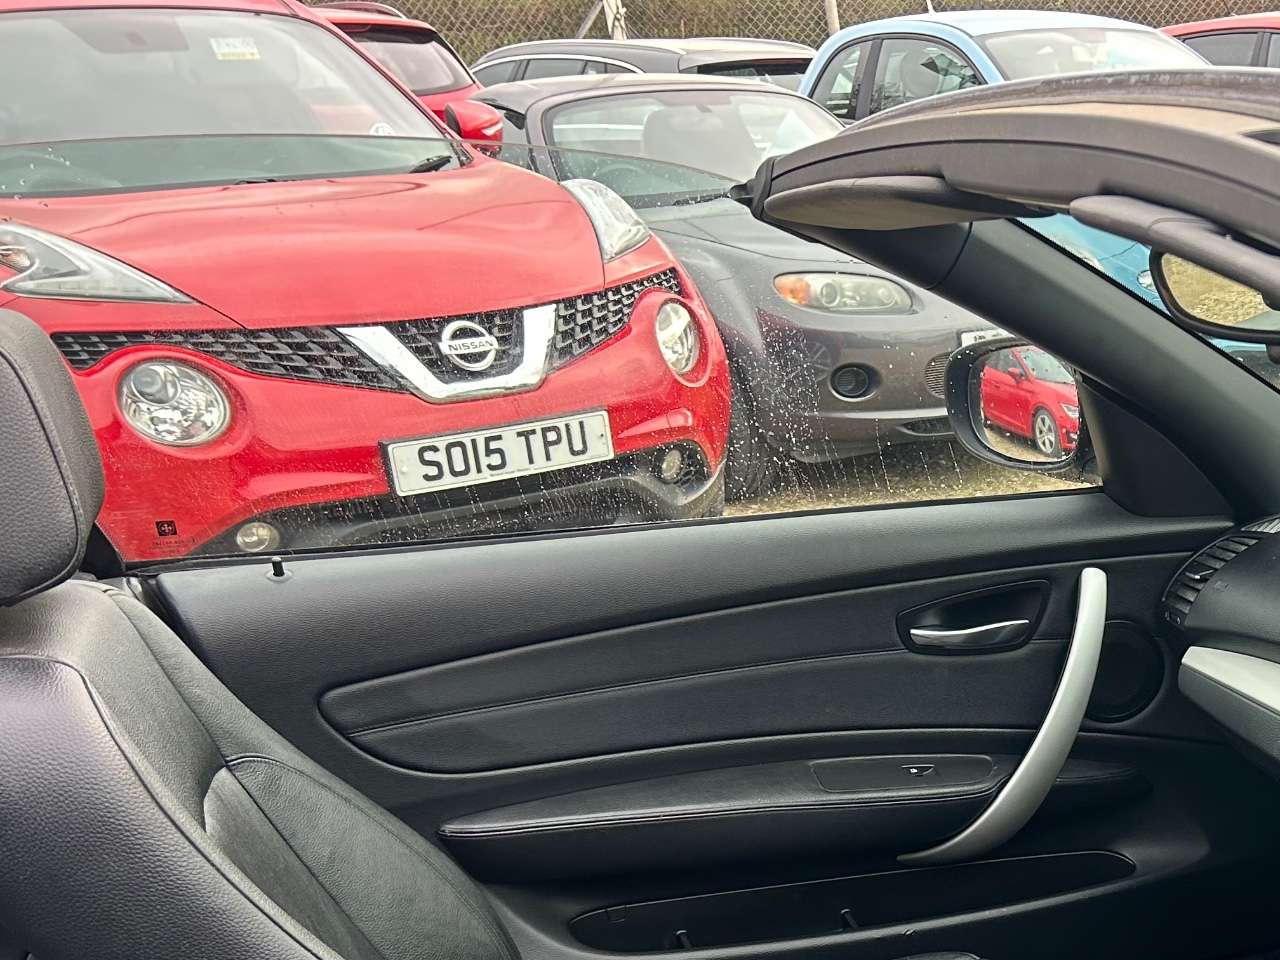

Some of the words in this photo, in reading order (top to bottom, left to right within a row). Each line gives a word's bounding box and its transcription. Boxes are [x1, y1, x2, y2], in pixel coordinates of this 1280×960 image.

[447, 338, 494, 352] NISSAN
[417, 434, 508, 482] SO15
[516, 420, 589, 465] TPU
